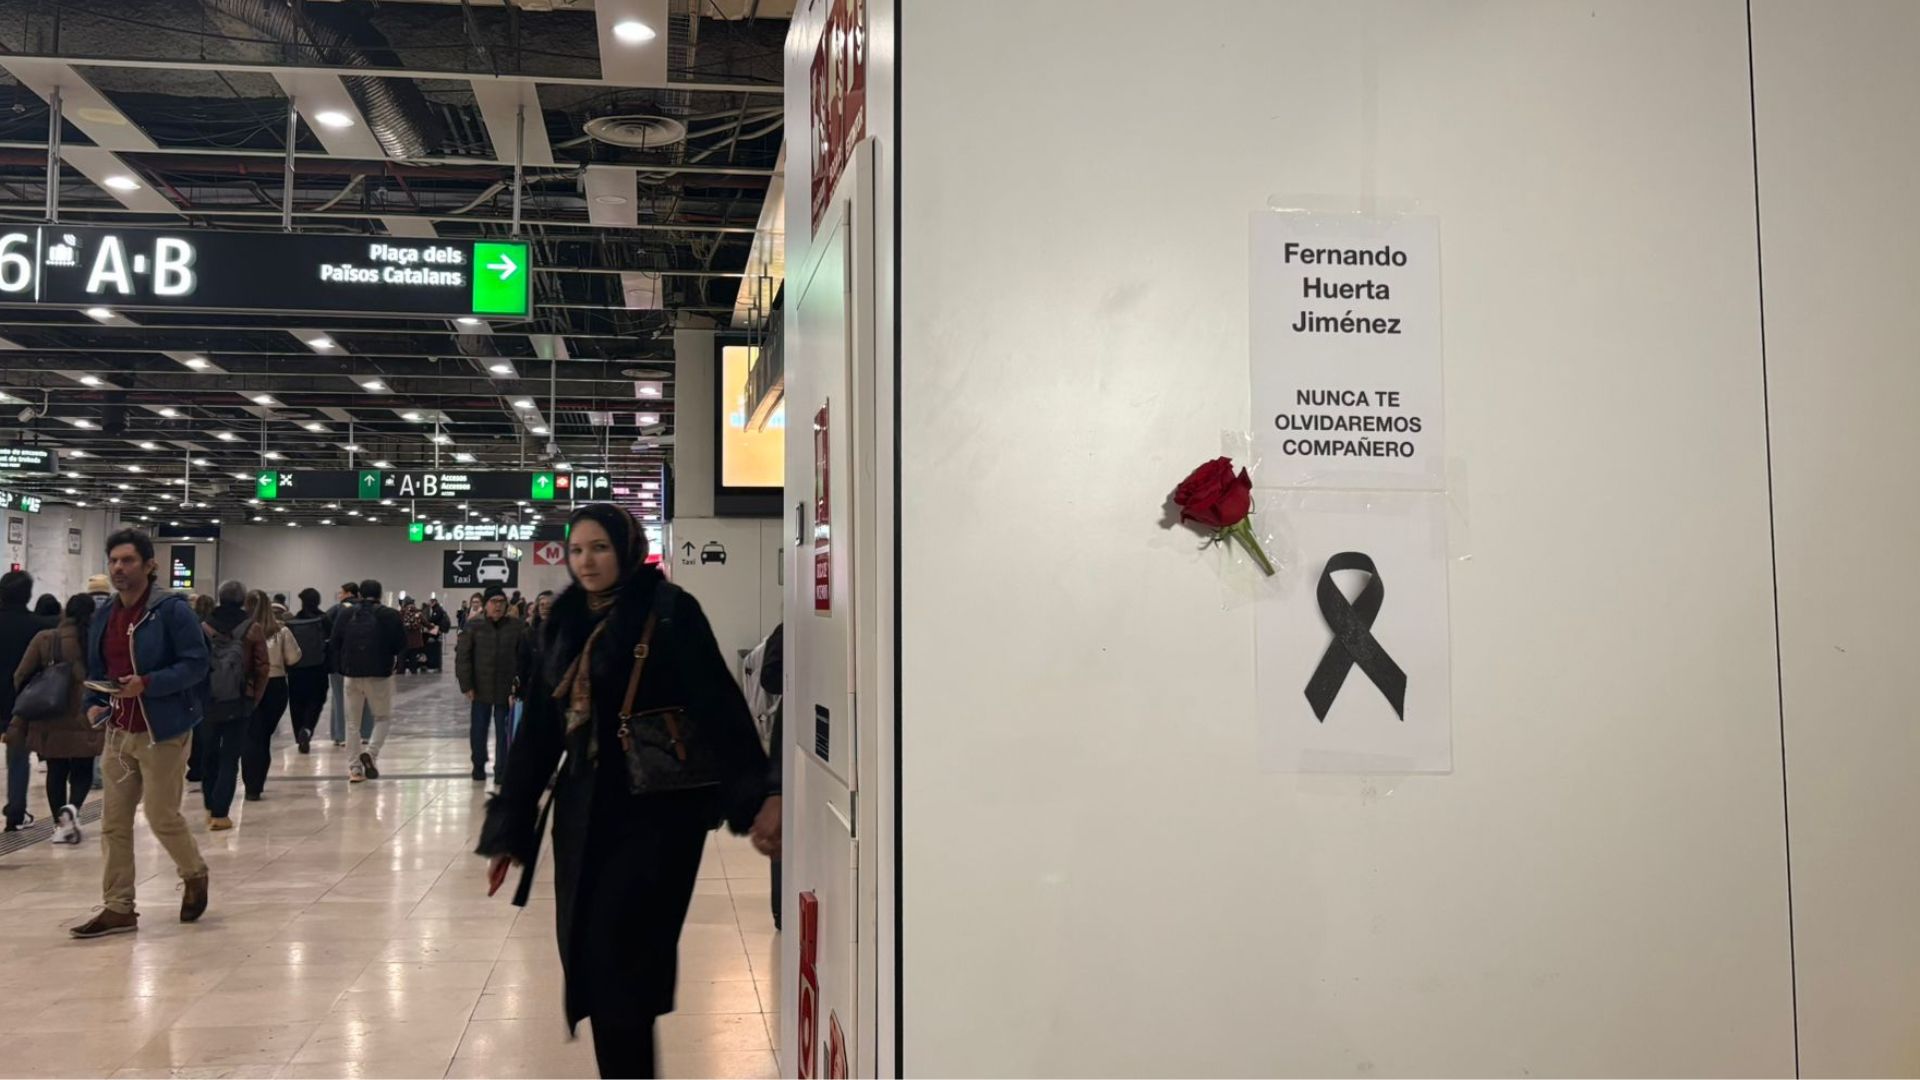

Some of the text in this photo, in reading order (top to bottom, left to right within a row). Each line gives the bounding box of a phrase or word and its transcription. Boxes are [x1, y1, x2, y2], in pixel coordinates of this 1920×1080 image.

[370, 244, 461, 264] Plaça dels
[1284, 242, 1407, 266] Fernando
[321, 264, 461, 285] Països Catalans
[1302, 277, 1390, 300] Huerta
[1292, 310, 1401, 334] Jiménez
[1296, 390, 1400, 407] NUNCA TE
[1274, 414, 1422, 433] OLVIDAREMOS
[1282, 437, 1415, 457] COMPAÑERO
[434, 524, 464, 540] 1.6
[546, 548, 559, 559] M
[453, 575, 471, 584] Taxi
